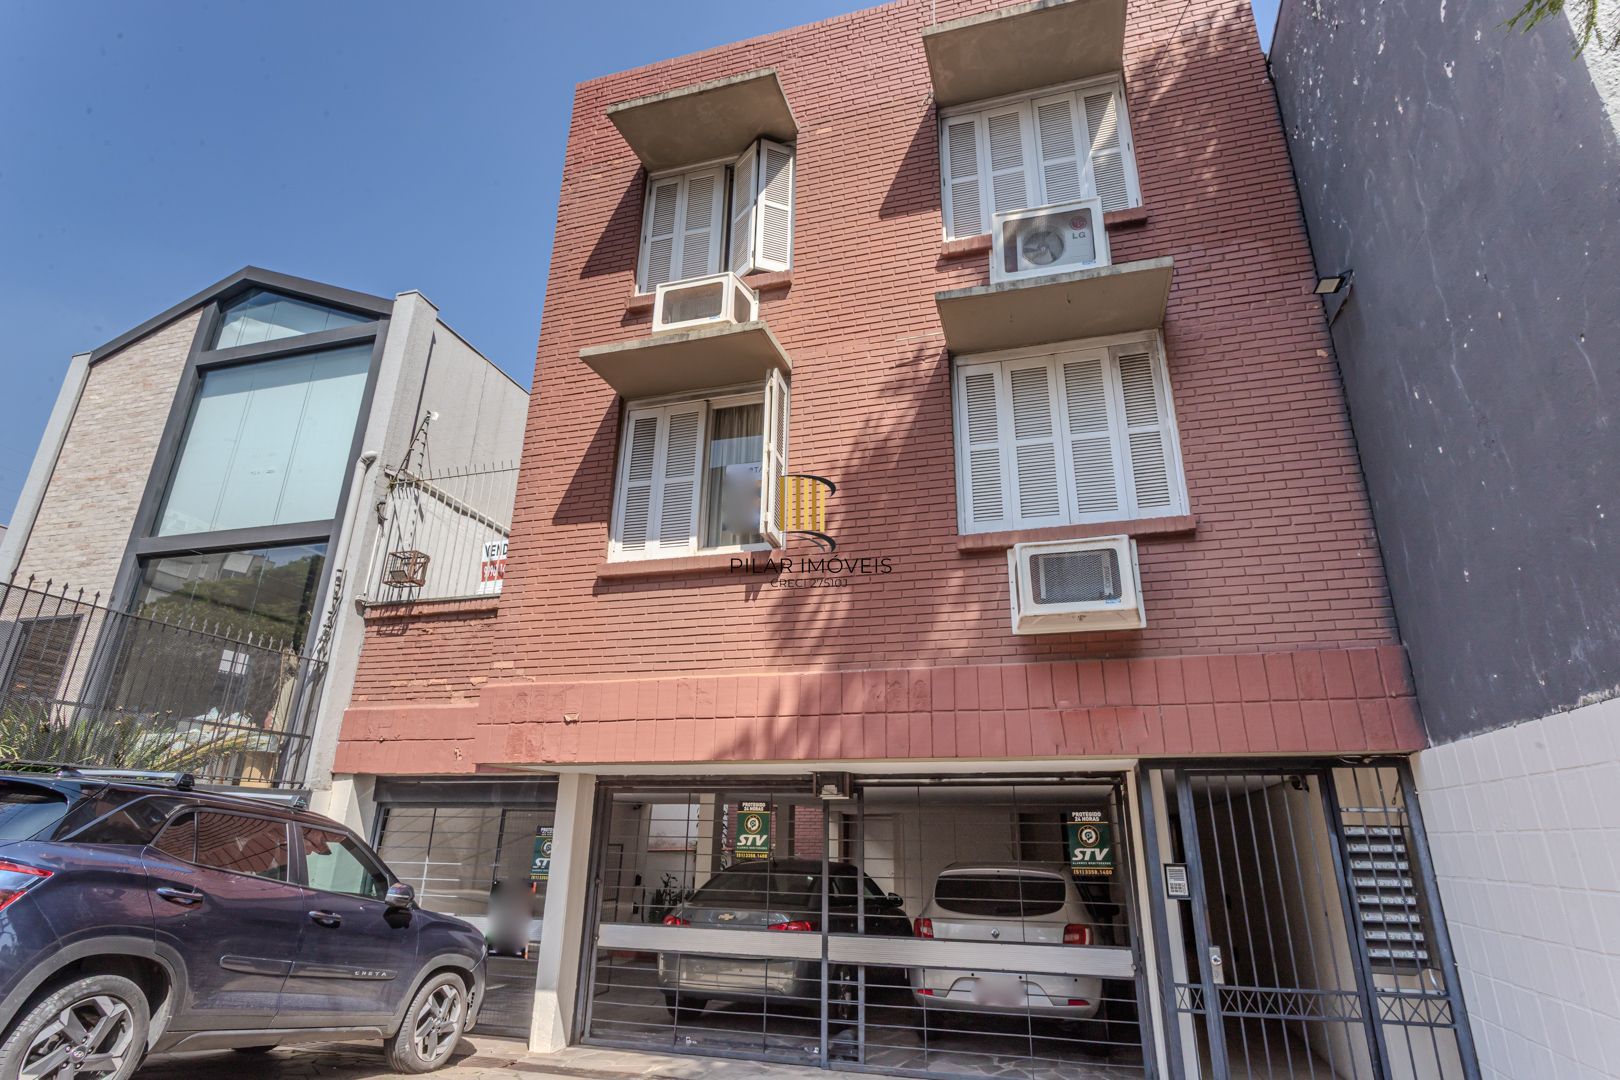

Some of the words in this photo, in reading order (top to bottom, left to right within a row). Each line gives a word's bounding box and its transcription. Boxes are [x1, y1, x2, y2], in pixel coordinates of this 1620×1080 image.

[1072, 231, 1086, 240] LG
[736, 834, 768, 846] STV
[1071, 847, 1110, 861] STV
